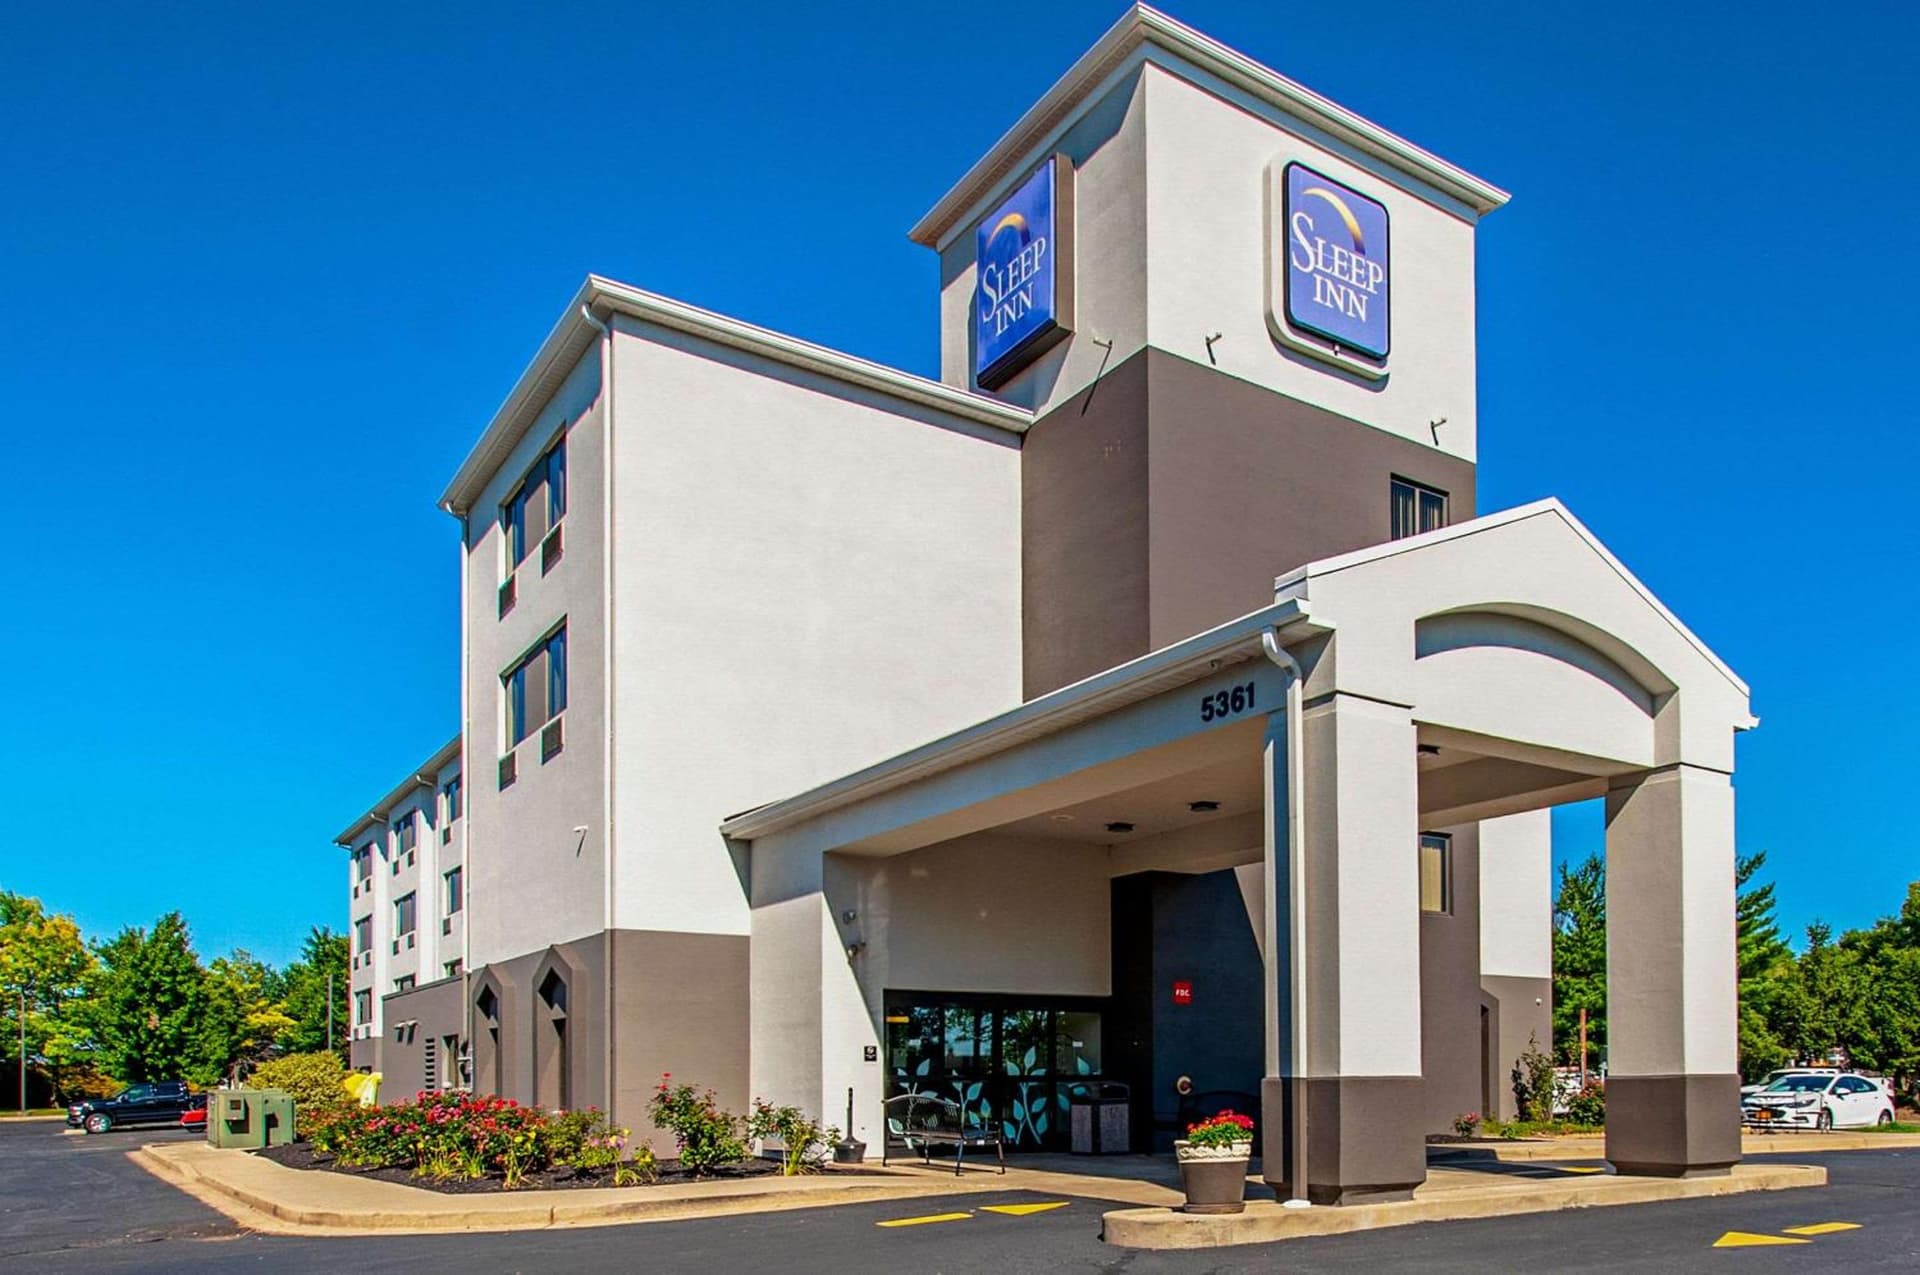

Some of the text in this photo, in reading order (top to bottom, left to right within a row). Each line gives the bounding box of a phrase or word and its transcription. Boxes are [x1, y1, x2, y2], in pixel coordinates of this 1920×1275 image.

[982, 237, 1047, 323] SLEEP
[1292, 211, 1383, 295] SLEEP
[995, 282, 1034, 337] INN
[1313, 273, 1368, 322] INN
[1201, 681, 1255, 722] 5361
